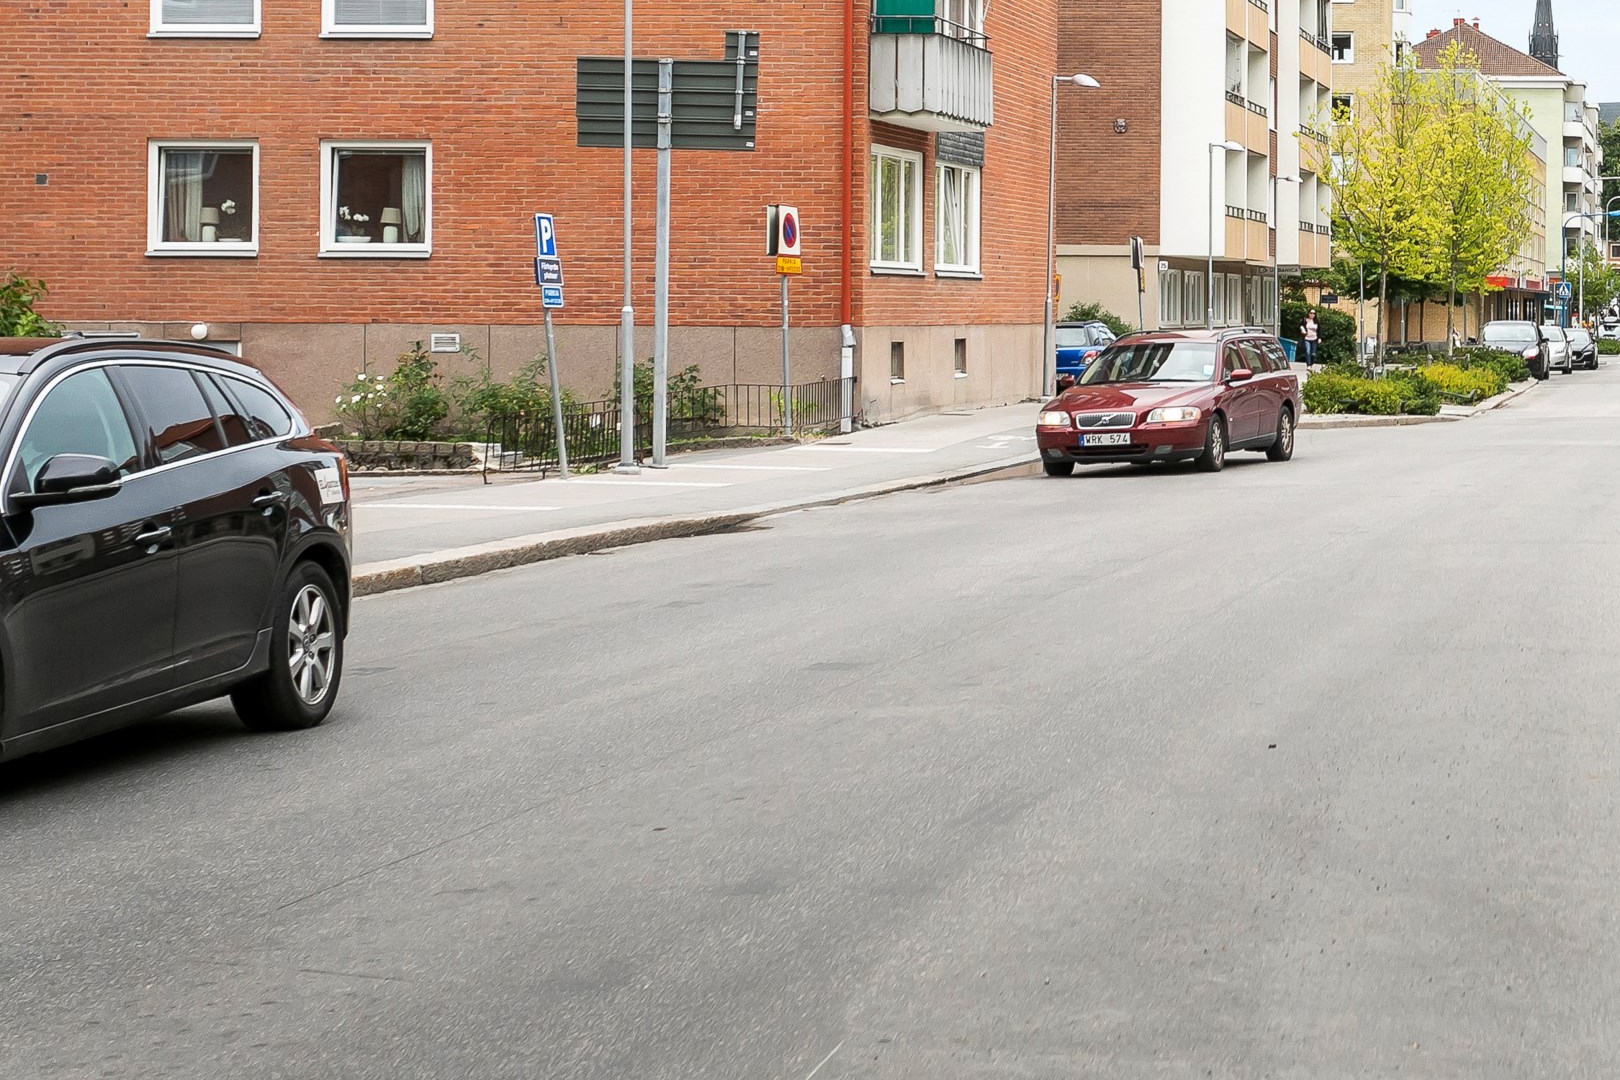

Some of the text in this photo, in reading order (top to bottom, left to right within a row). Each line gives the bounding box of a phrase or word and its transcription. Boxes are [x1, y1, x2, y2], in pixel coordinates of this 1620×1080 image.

[540, 218, 552, 253] P
[1085, 434, 1128, 445] WRK 574
